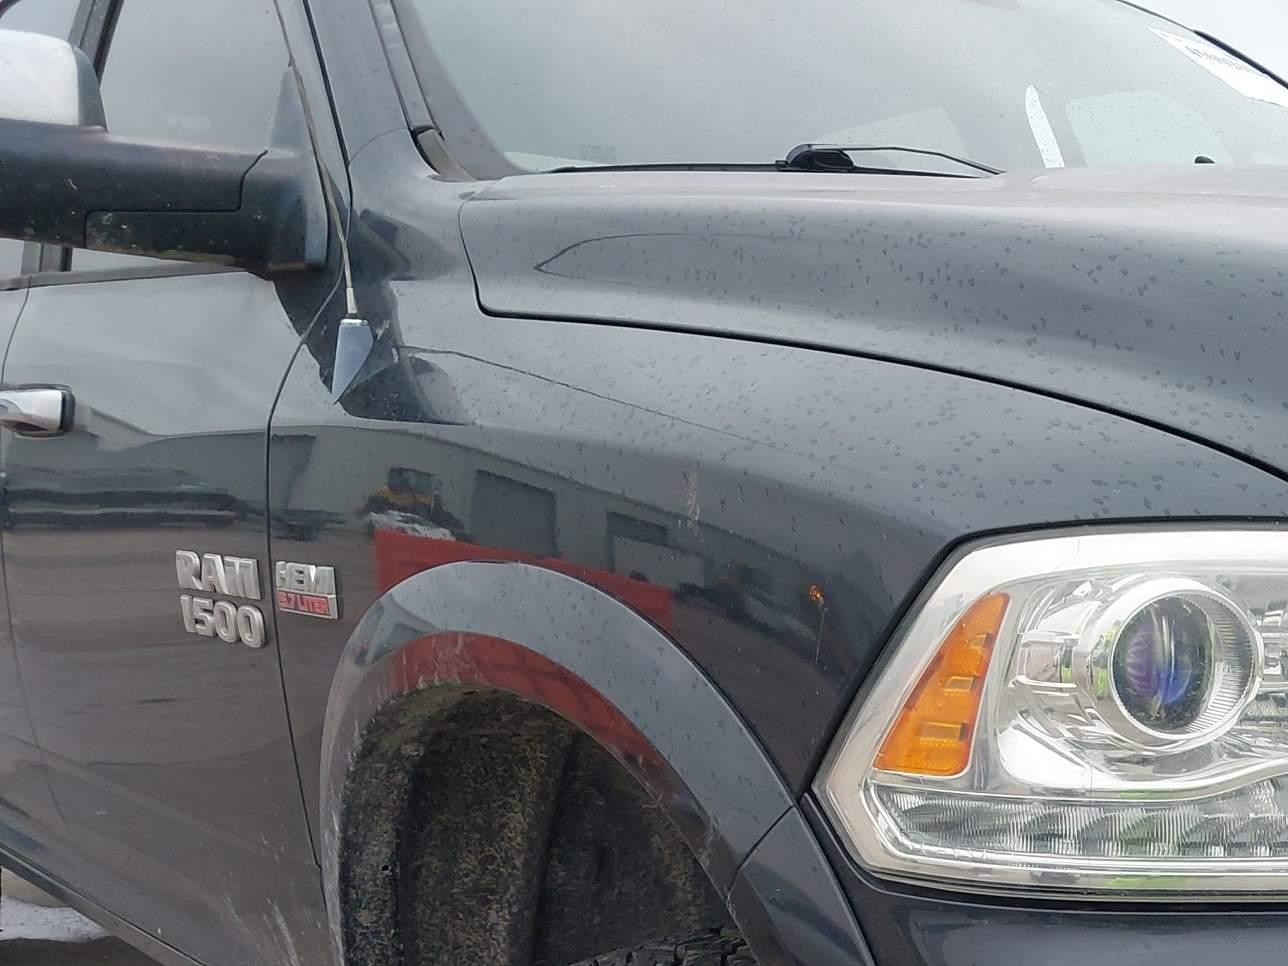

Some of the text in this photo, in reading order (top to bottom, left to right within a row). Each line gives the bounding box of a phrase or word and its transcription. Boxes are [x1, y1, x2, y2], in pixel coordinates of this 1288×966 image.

[176, 550, 261, 600] RAM
[275, 561, 336, 595] HEMI
[180, 594, 265, 648] 1500
